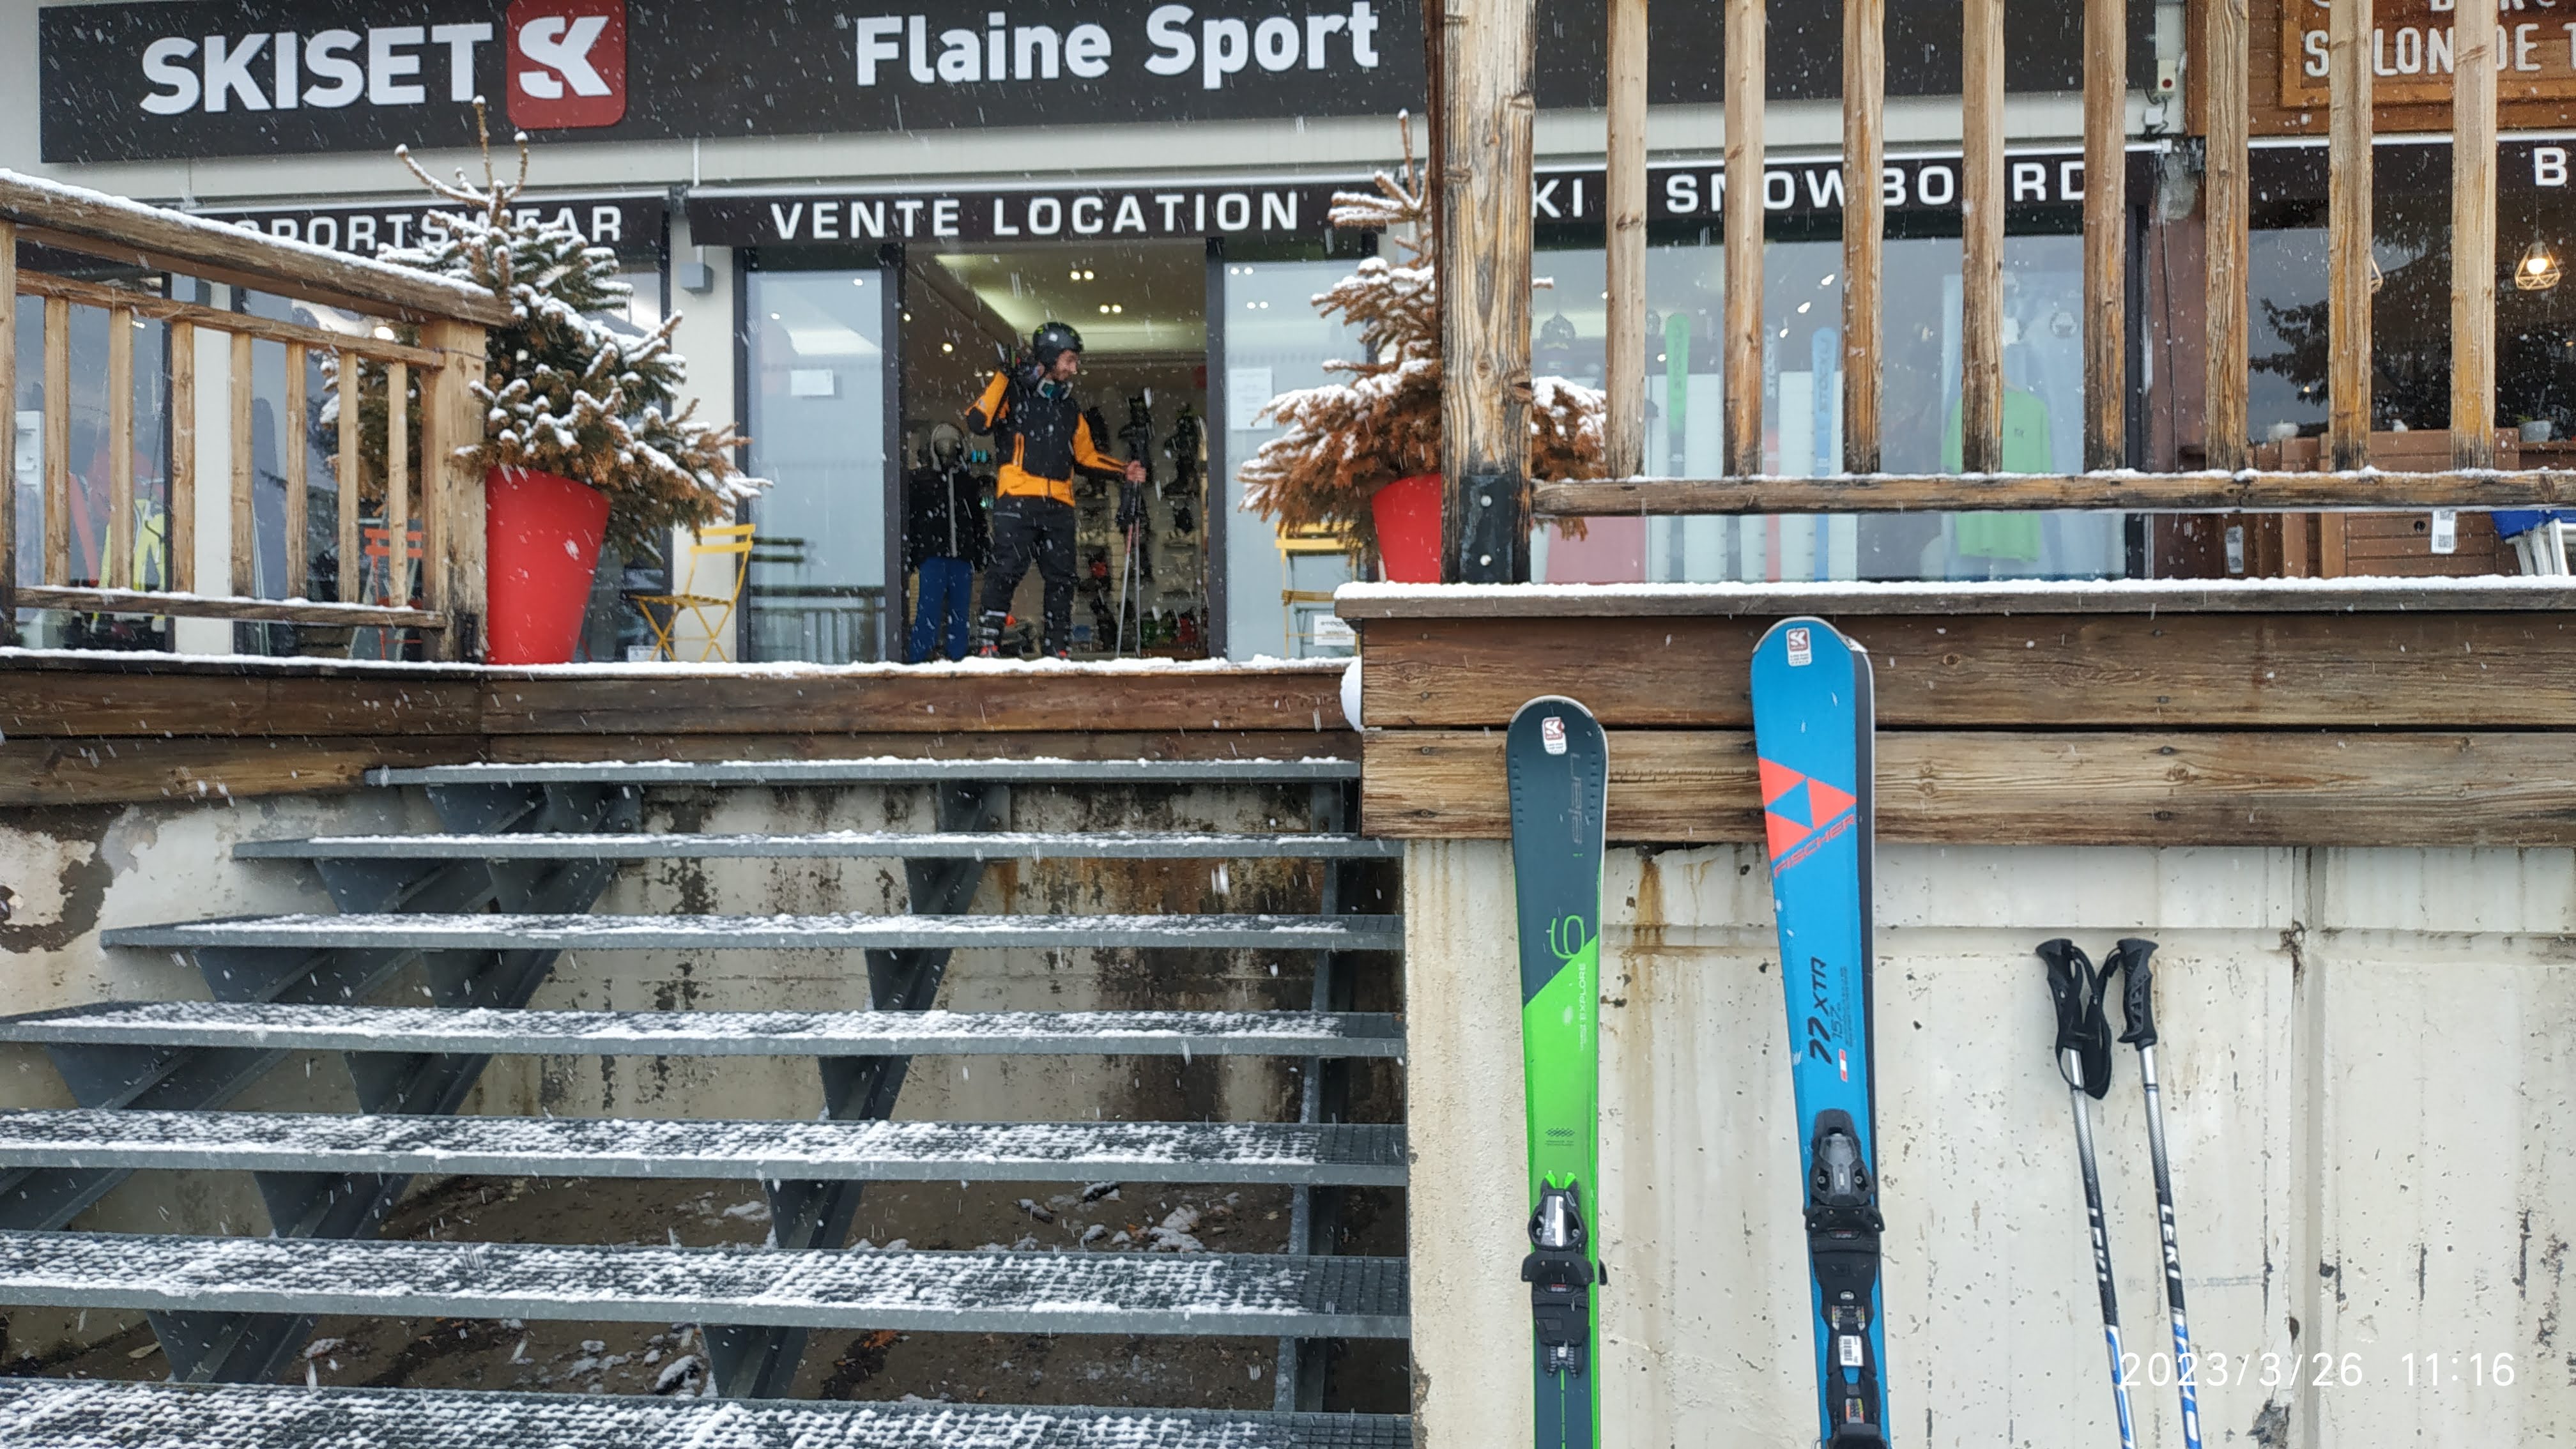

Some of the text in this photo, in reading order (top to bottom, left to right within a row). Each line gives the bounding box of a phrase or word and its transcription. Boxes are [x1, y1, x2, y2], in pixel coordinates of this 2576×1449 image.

[139, 22, 493, 115] SKISET
[516, 15, 613, 99] SK
[856, 1, 1380, 89] Flaine Sport
[2304, 27, 2454, 77] SLON
[770, 197, 961, 240] VENTE
[993, 192, 1299, 235] LOCATION
[1533, 178, 1583, 218] KI
[1807, 956, 1832, 1065] 77 XTR
[2159, 1203, 2182, 1280] LEKI
